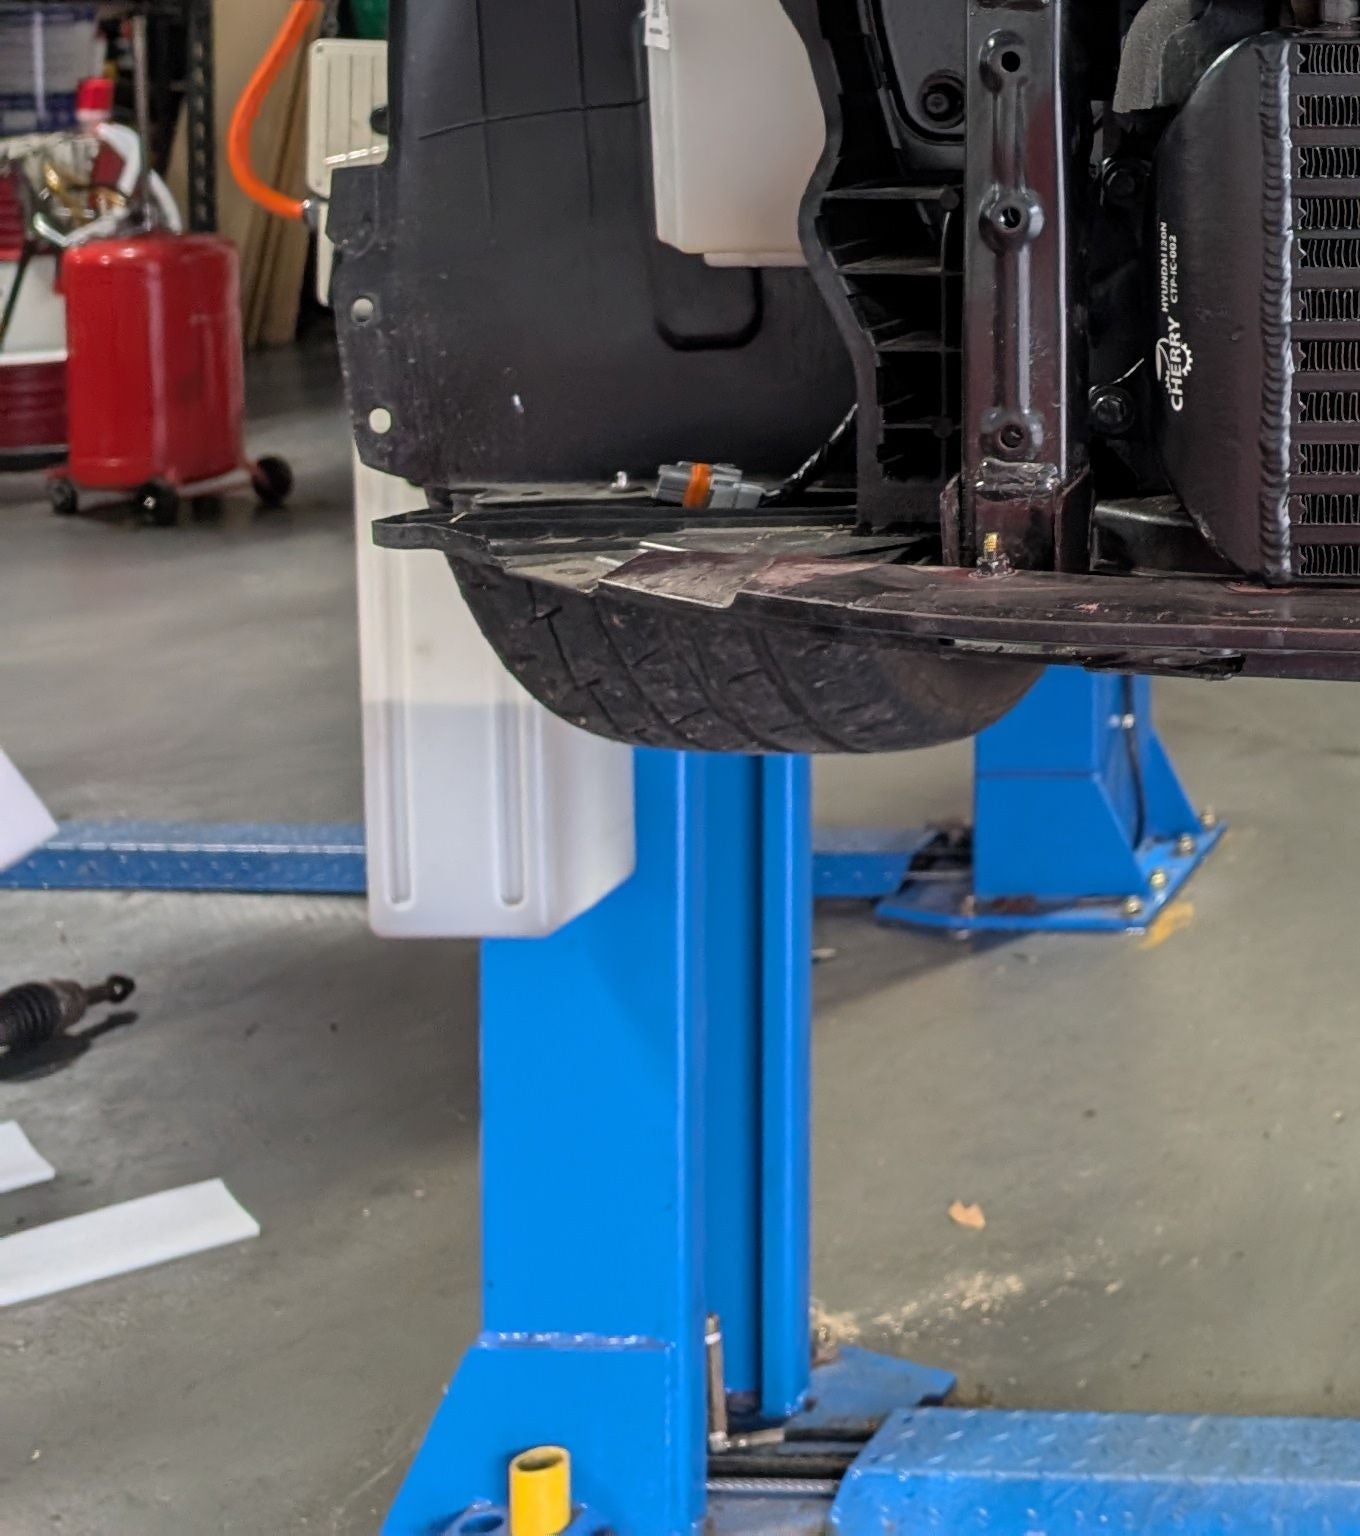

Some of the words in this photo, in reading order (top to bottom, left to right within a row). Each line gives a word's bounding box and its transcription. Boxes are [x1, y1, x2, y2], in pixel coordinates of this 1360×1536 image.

[1160, 253, 1169, 313] HYUNDAI
[1168, 234, 1179, 304] CTP-IC-002
[1167, 315, 1185, 412] CHERRY
